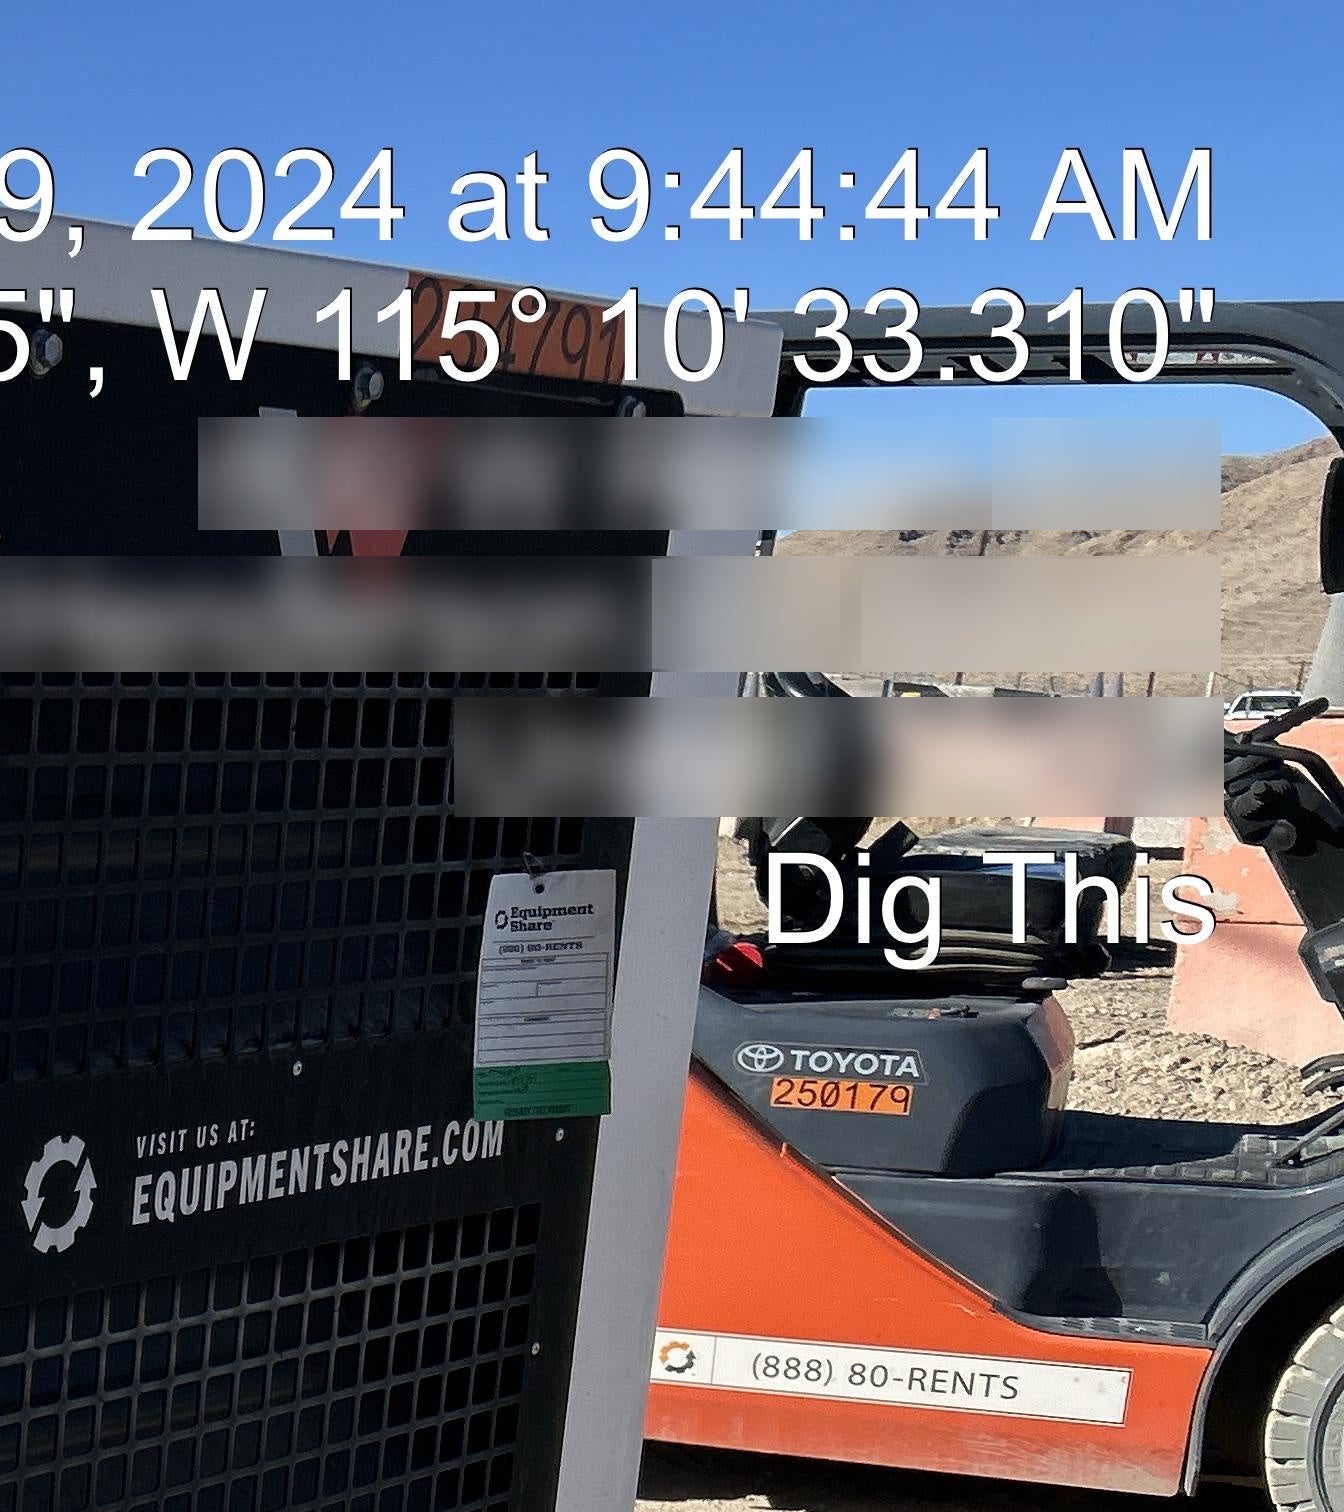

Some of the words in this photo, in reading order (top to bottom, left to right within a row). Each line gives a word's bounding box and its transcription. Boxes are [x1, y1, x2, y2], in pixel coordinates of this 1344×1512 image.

[510, 904, 594, 920] Equipment
[510, 920, 553, 932] Share
[790, 1049, 920, 1077] TOYOTA
[773, 1078, 910, 1113] 250179
[136, 1128, 188, 1160] VISIT
[196, 1123, 219, 1149] US
[227, 1118, 256, 1144] AT:
[131, 1119, 505, 1226] EQUIPMENTSHARE.COM
[752, 1353, 833, 1386] (888)
[847, 1363, 1019, 1399] 80-RENTS
